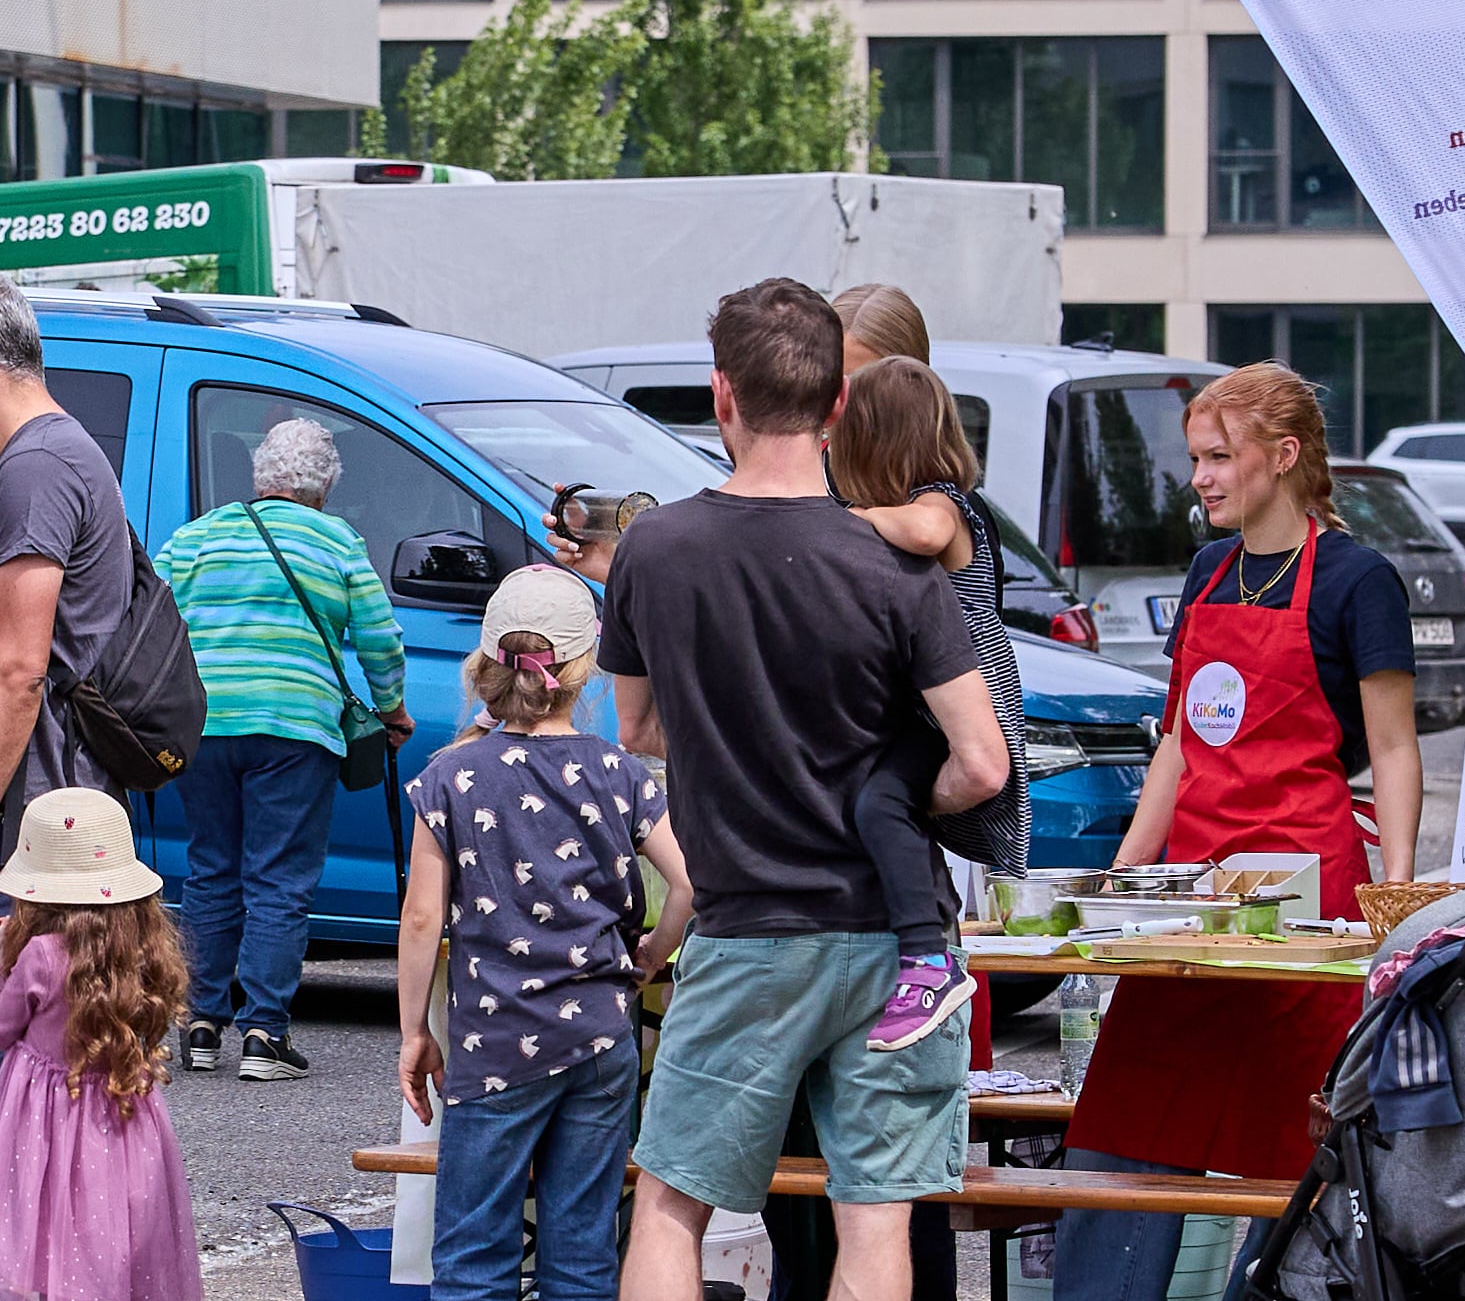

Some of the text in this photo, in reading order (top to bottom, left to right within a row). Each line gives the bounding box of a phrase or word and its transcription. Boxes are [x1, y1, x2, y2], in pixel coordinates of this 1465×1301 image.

[70, 209, 106, 237] 80
[112, 206, 149, 234] 62
[155, 201, 210, 229] 230
[1192, 702, 1235, 718] KiKoMo
